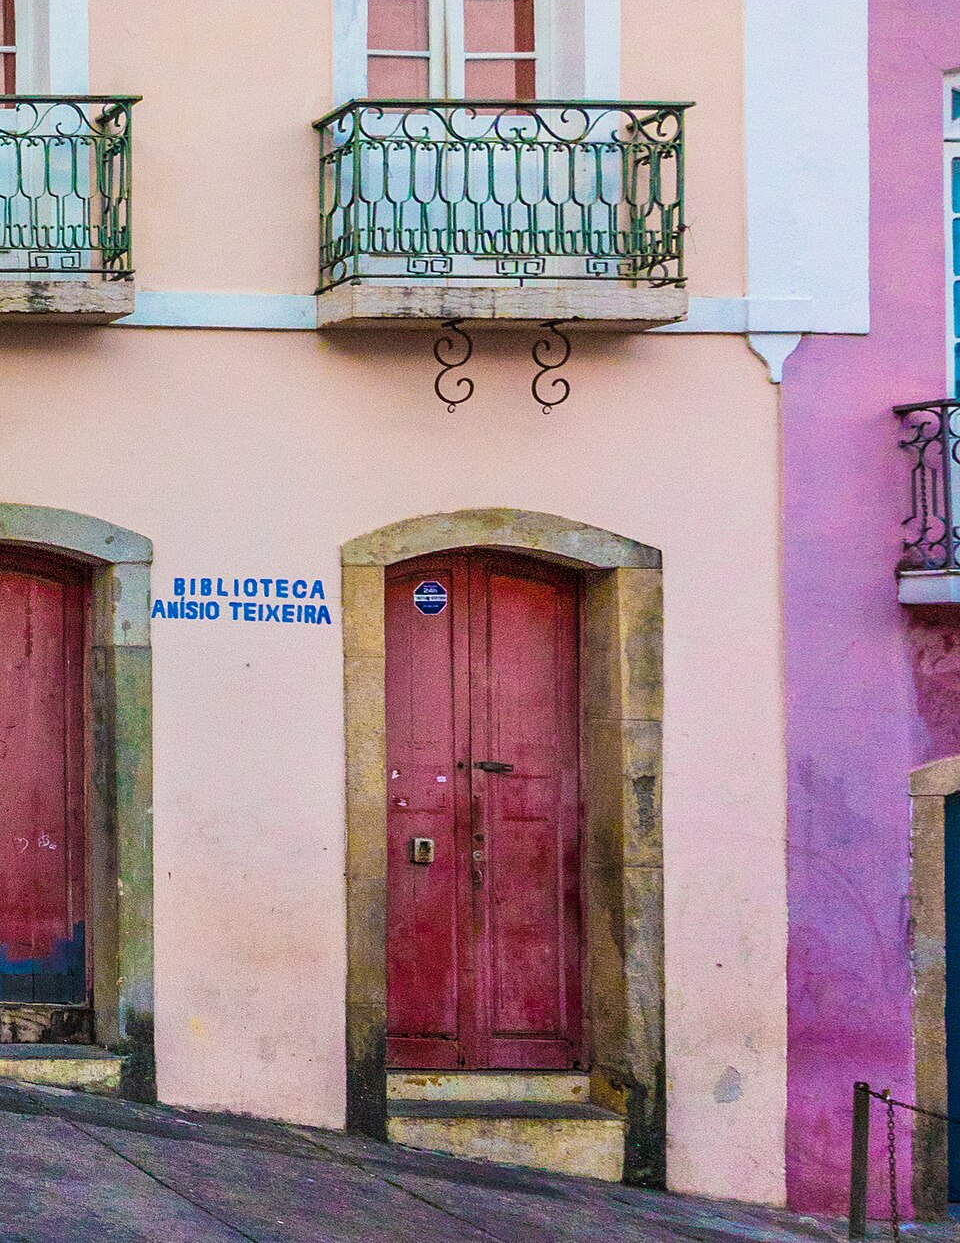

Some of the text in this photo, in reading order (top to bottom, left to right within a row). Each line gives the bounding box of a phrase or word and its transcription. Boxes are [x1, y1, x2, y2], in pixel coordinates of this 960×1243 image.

[173, 577, 325, 600] BIBLIOTECA
[151, 596, 332, 625] ANÍSIO TEIXEIRA
